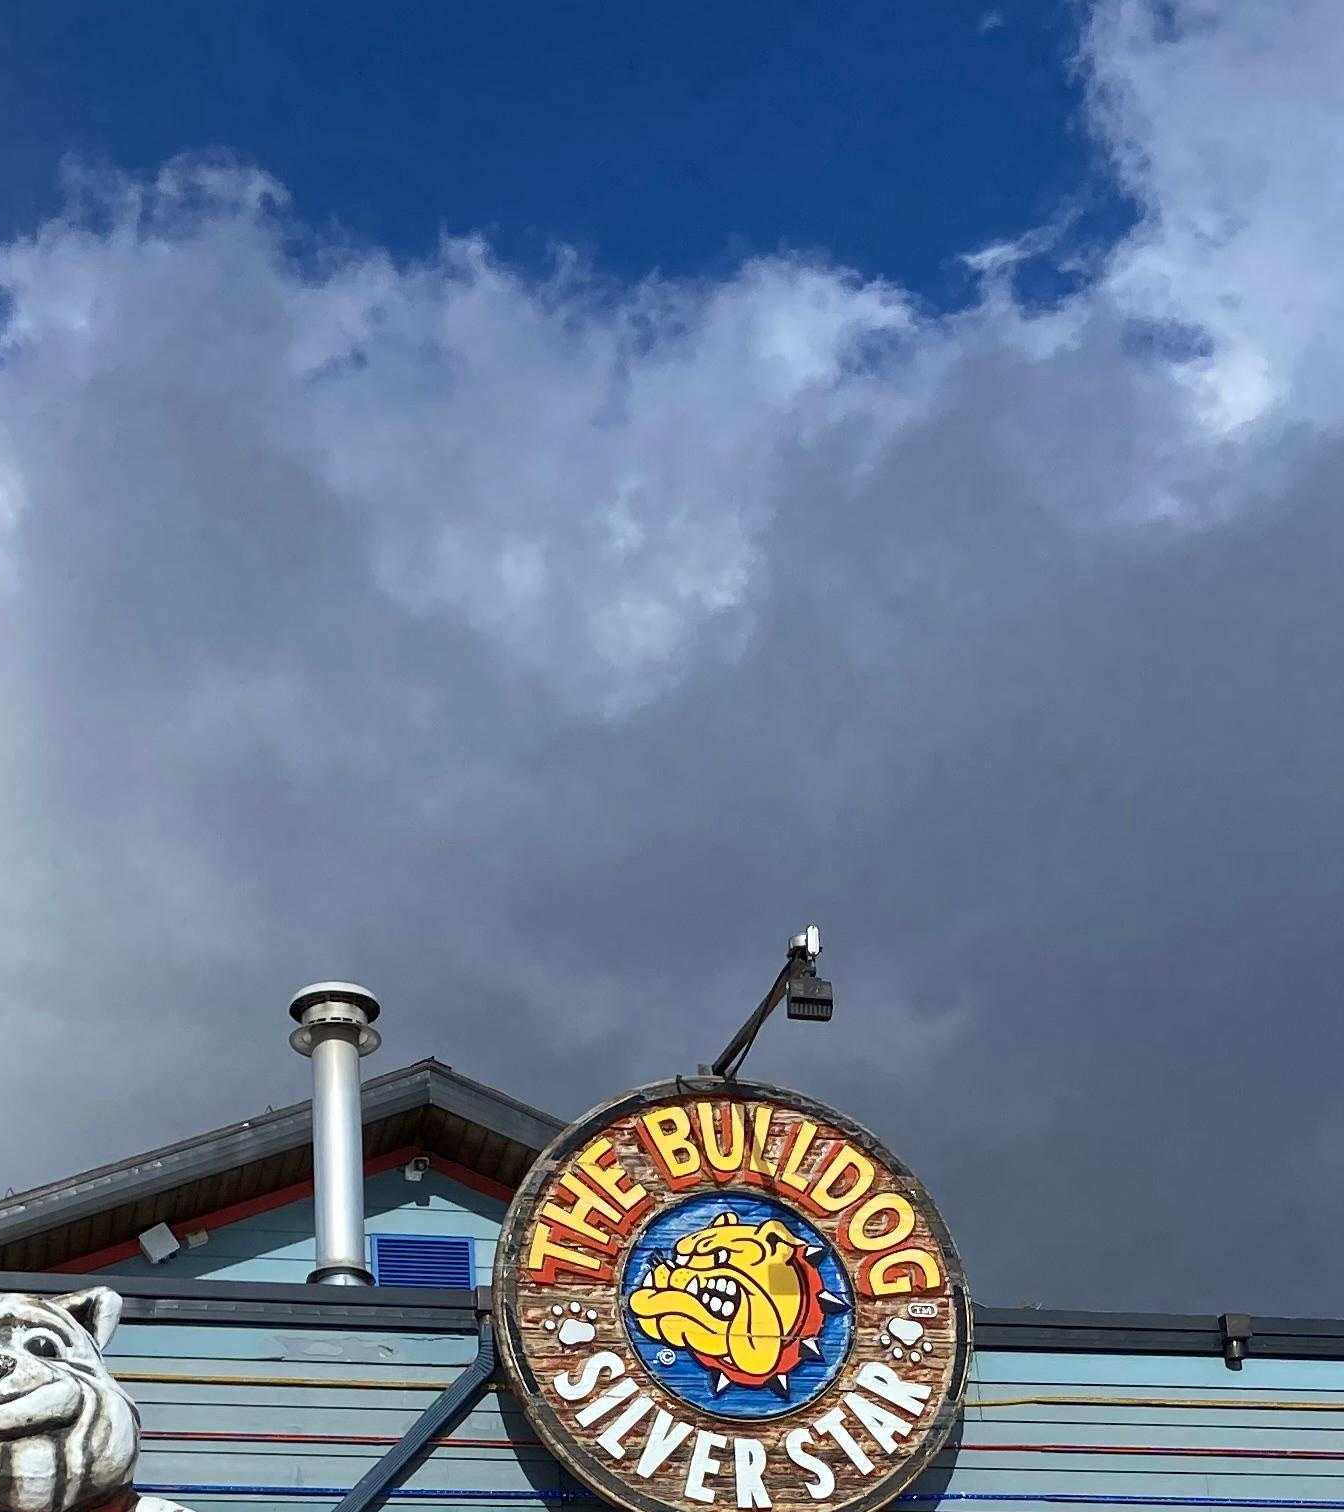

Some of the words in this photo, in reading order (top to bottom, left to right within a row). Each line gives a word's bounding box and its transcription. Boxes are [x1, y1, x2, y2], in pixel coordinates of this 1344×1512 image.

[527, 1136, 648, 1271] THE
[642, 1102, 941, 1296] BULLDOG
[554, 1352, 772, 1509] SILVER
[786, 1362, 932, 1499] STAR
